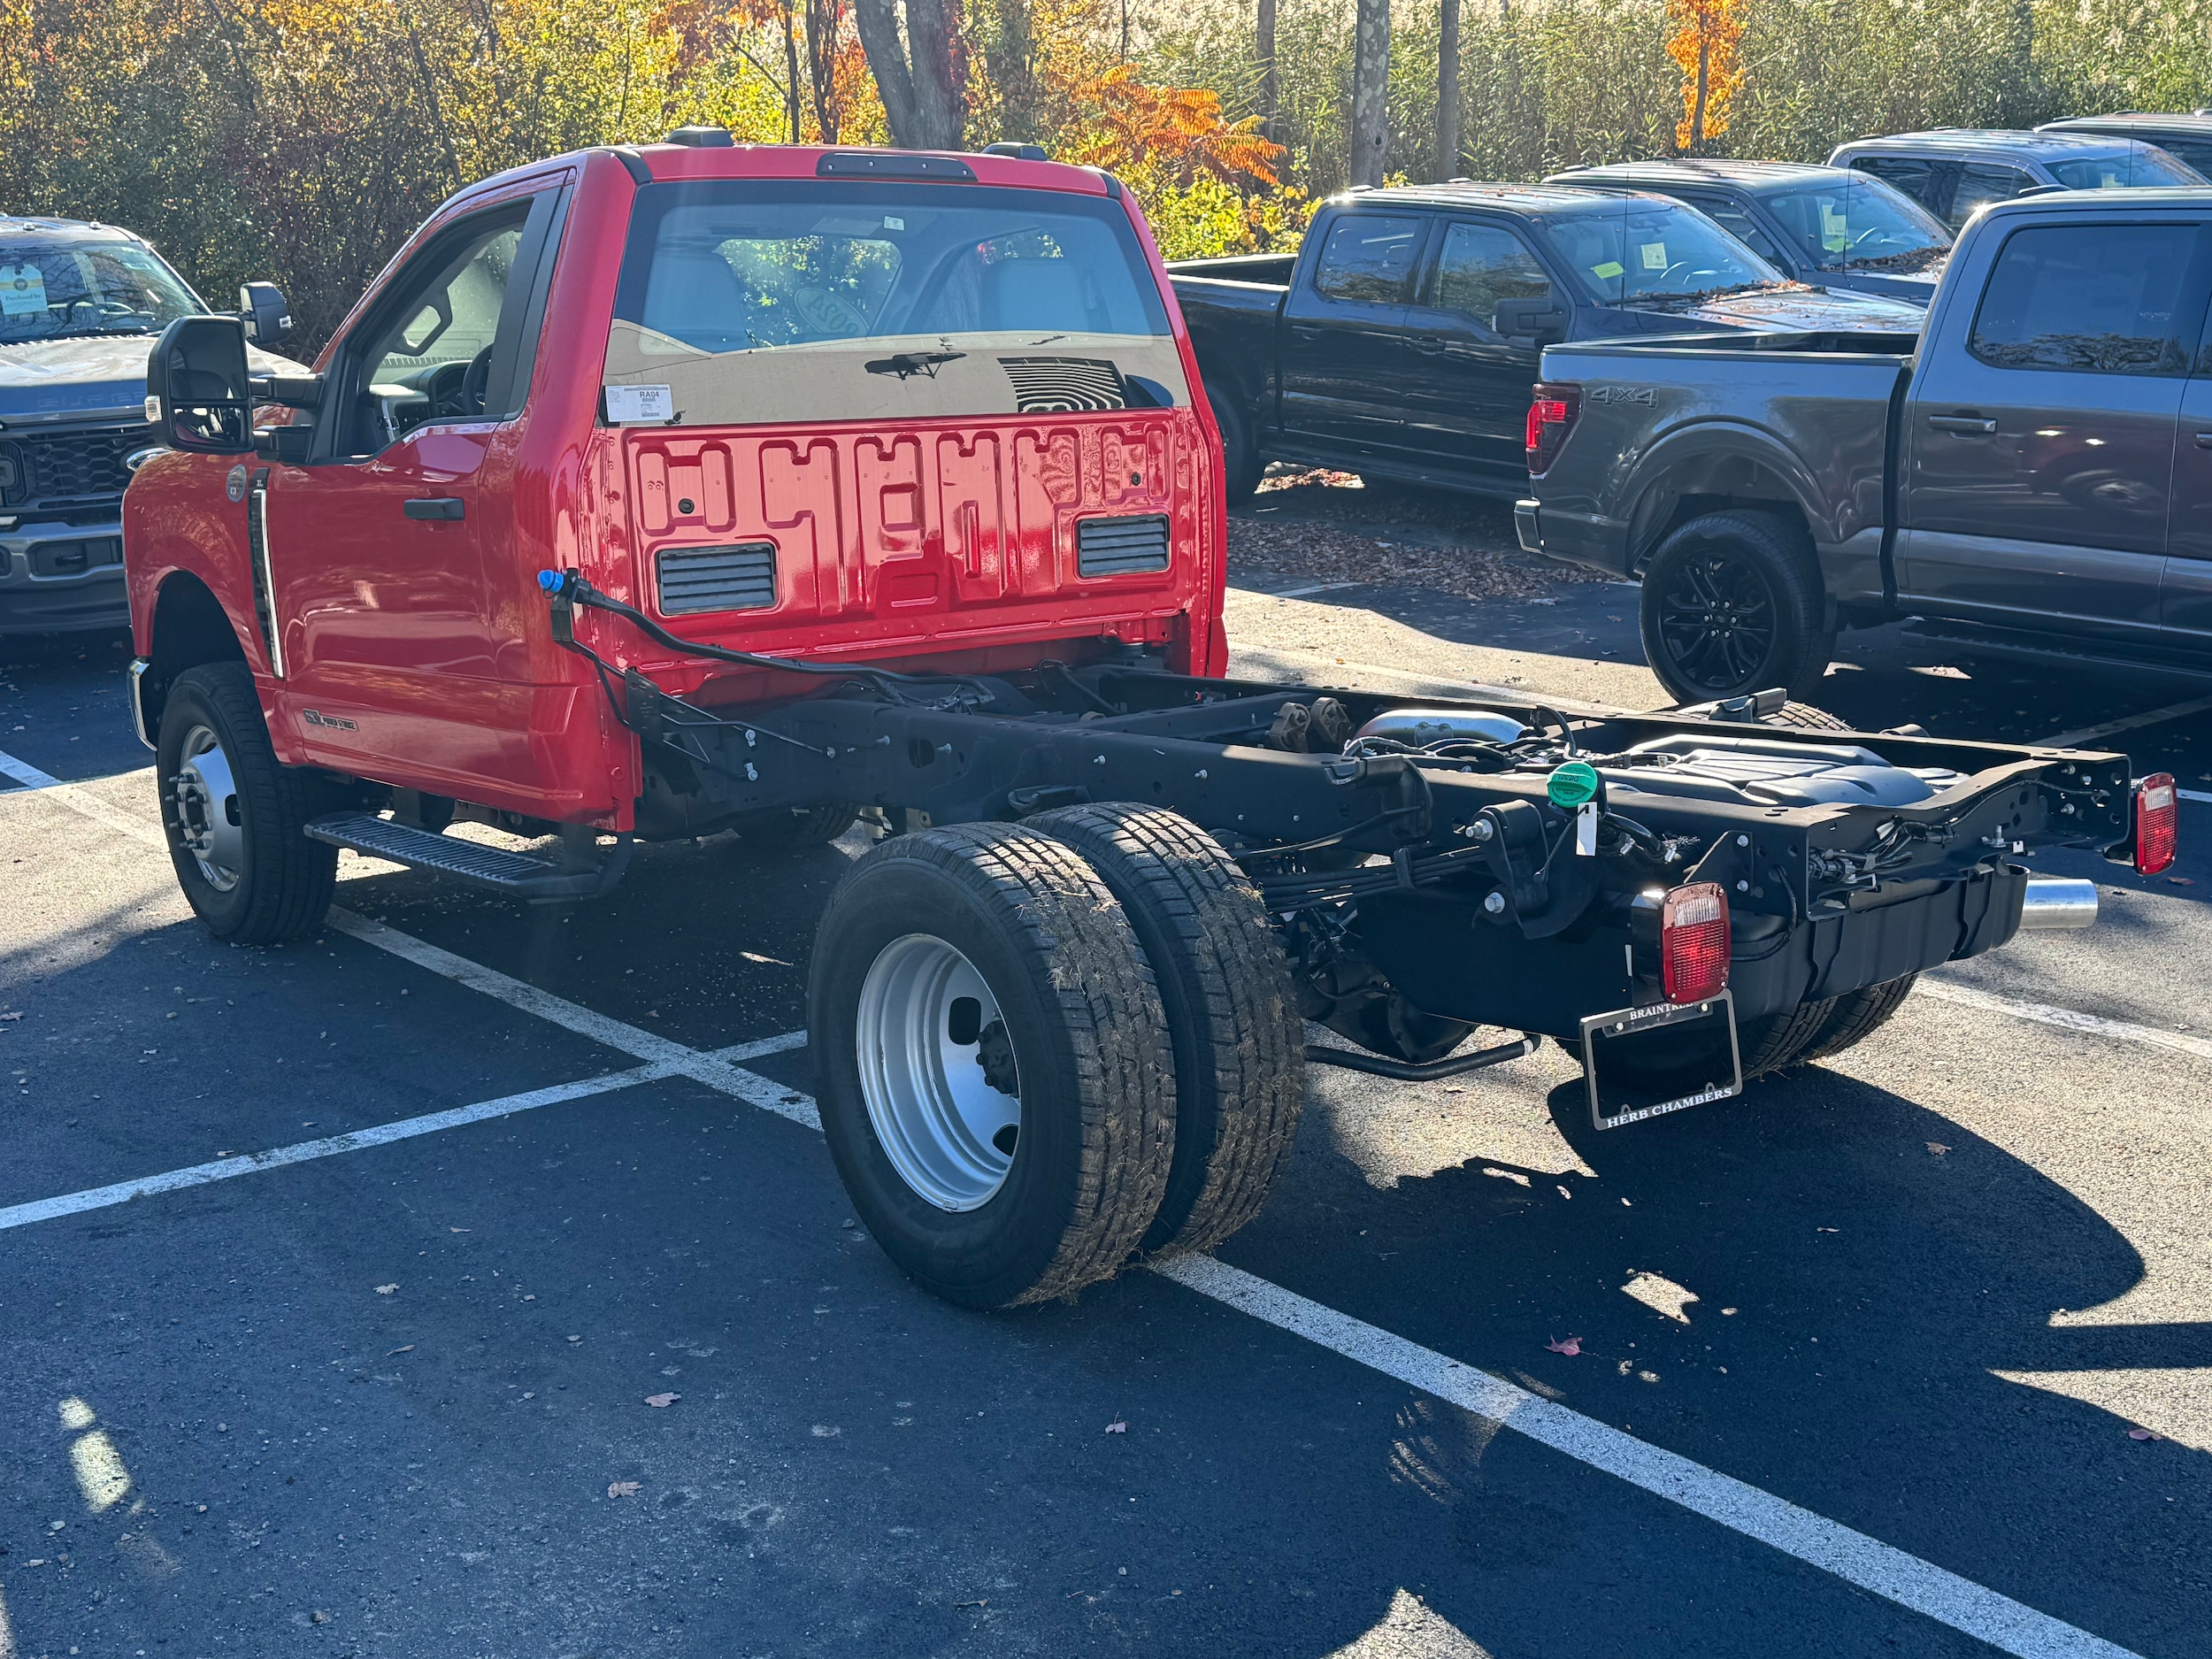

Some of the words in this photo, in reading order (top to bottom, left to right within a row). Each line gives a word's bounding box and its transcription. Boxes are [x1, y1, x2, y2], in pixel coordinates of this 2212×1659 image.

[1557, 773, 1579, 782] DIESEL
[1607, 1110, 1649, 1128] HERB
[1651, 1087, 1733, 1116] CHAMBERS
